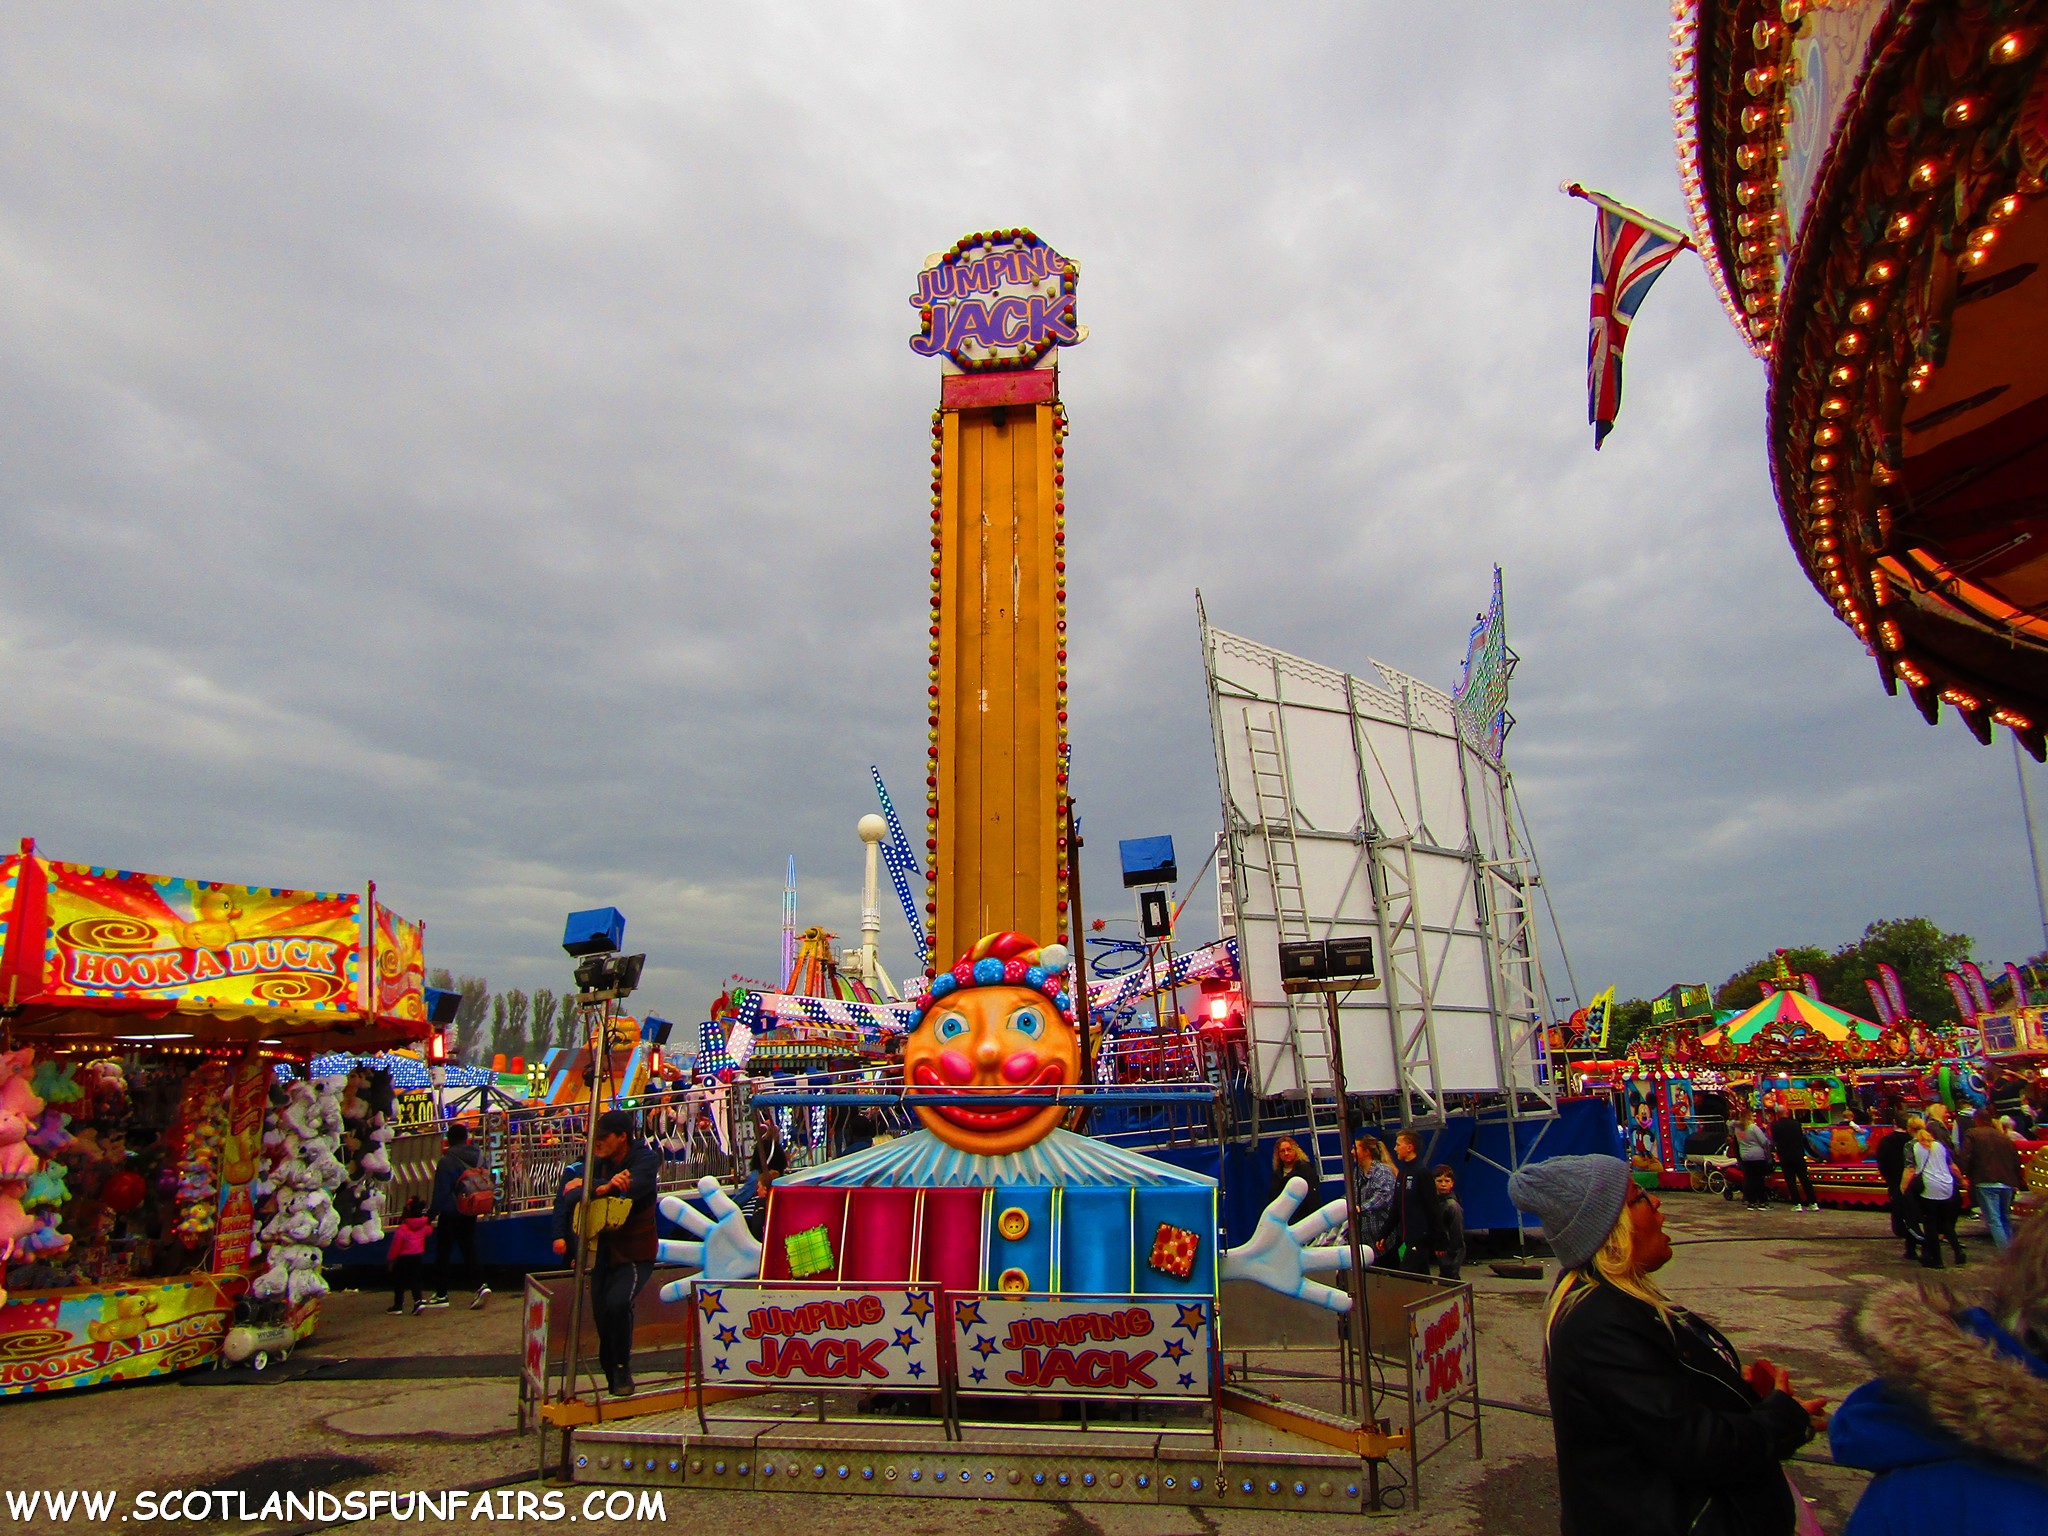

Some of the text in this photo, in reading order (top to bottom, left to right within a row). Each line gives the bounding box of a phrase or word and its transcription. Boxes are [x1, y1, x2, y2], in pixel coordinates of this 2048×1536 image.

[909, 246, 1069, 307] JUMPING
[909, 294, 1078, 357] JACK
[74, 938, 338, 989] HOOK A DUCK
[403, 1093, 428, 1103] FARE
[104, 1340, 135, 1365] A
[138, 1312, 227, 1350] DUCK
[742, 1294, 886, 1340] JUMPING
[1002, 1306, 1155, 1350] JUMPING
[746, 1337, 890, 1379] JACK
[1005, 1346, 1159, 1389] JACK
[1424, 1343, 1464, 1403] JACK
